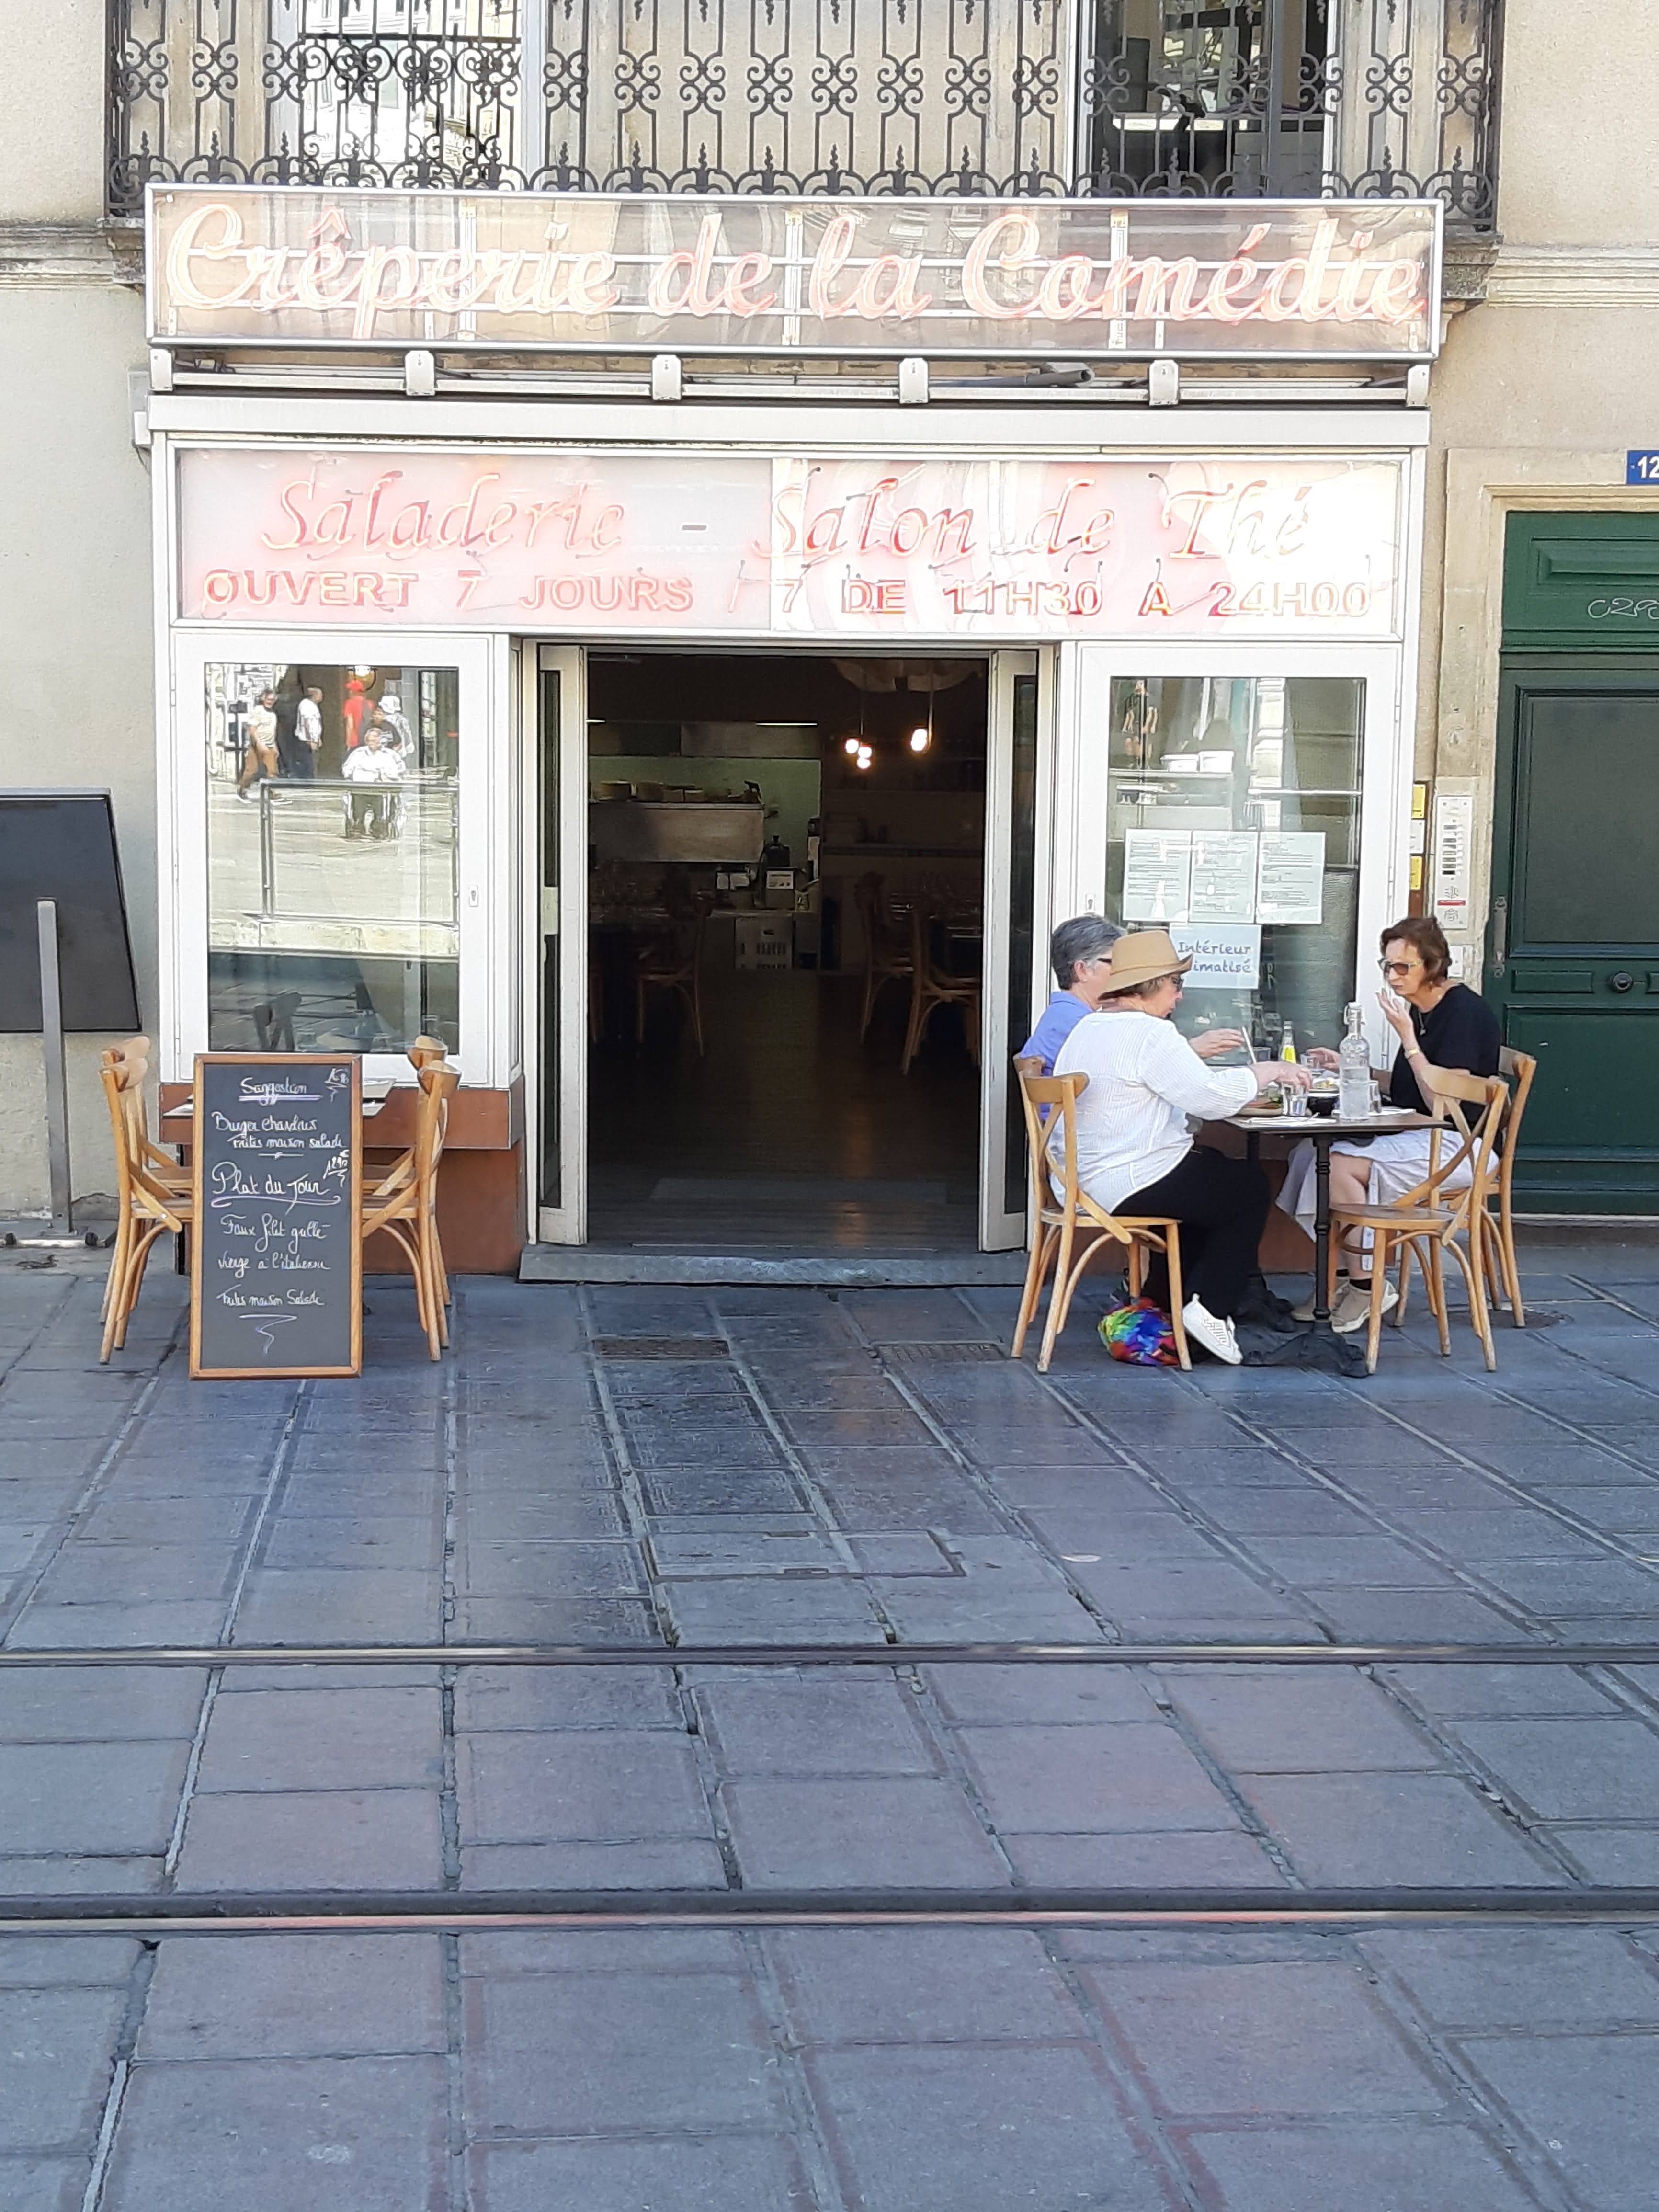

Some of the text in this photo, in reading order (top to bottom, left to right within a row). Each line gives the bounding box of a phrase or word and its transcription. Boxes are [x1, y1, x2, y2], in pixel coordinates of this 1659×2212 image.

[167, 202, 1428, 339] Crêperie de la Comédie
[261, 469, 625, 552] Saladerie
[751, 476, 979, 559] Salon
[1025, 478, 1116, 556] de
[202, 568, 420, 609] OUVERT
[456, 569, 483, 609] 7
[518, 573, 696, 613] JOURS
[772, 578, 804, 614] 7
[841, 579, 906, 614] DE
[943, 578, 1102, 617] 11H30
[1138, 581, 1174, 618] A
[1208, 581, 1372, 618] 24H00
[1178, 940, 1251, 955] Intérieur
[1193, 958, 1252, 973] imatisé
[212, 1161, 261, 1195] Plat
[265, 1174, 287, 1194] du
